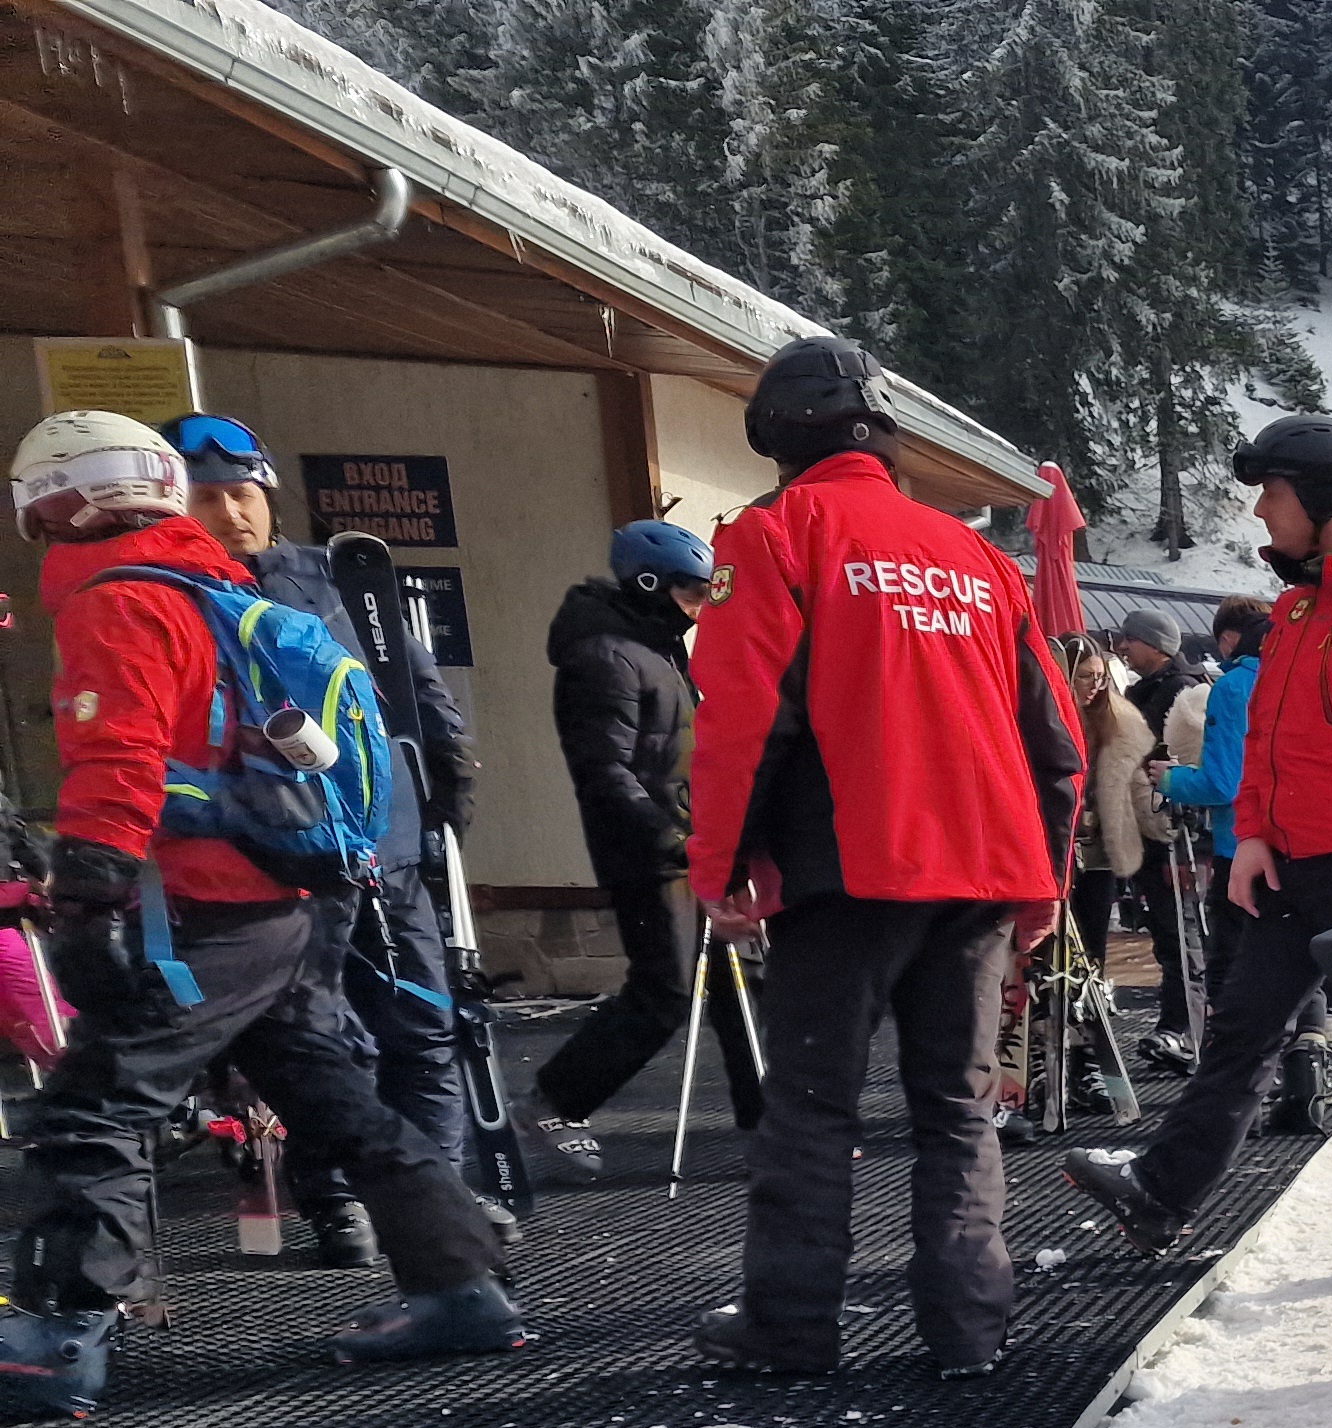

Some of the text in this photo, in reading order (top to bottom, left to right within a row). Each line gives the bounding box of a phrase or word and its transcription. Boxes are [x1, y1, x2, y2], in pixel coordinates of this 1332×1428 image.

[343, 462, 410, 488] ВХОД
[318, 488, 441, 514] ENTRANCE
[843, 560, 993, 614] RESCUE
[363, 592, 390, 664] HEAD
[893, 603, 972, 637] TEAM
[495, 1152, 513, 1191] shape
